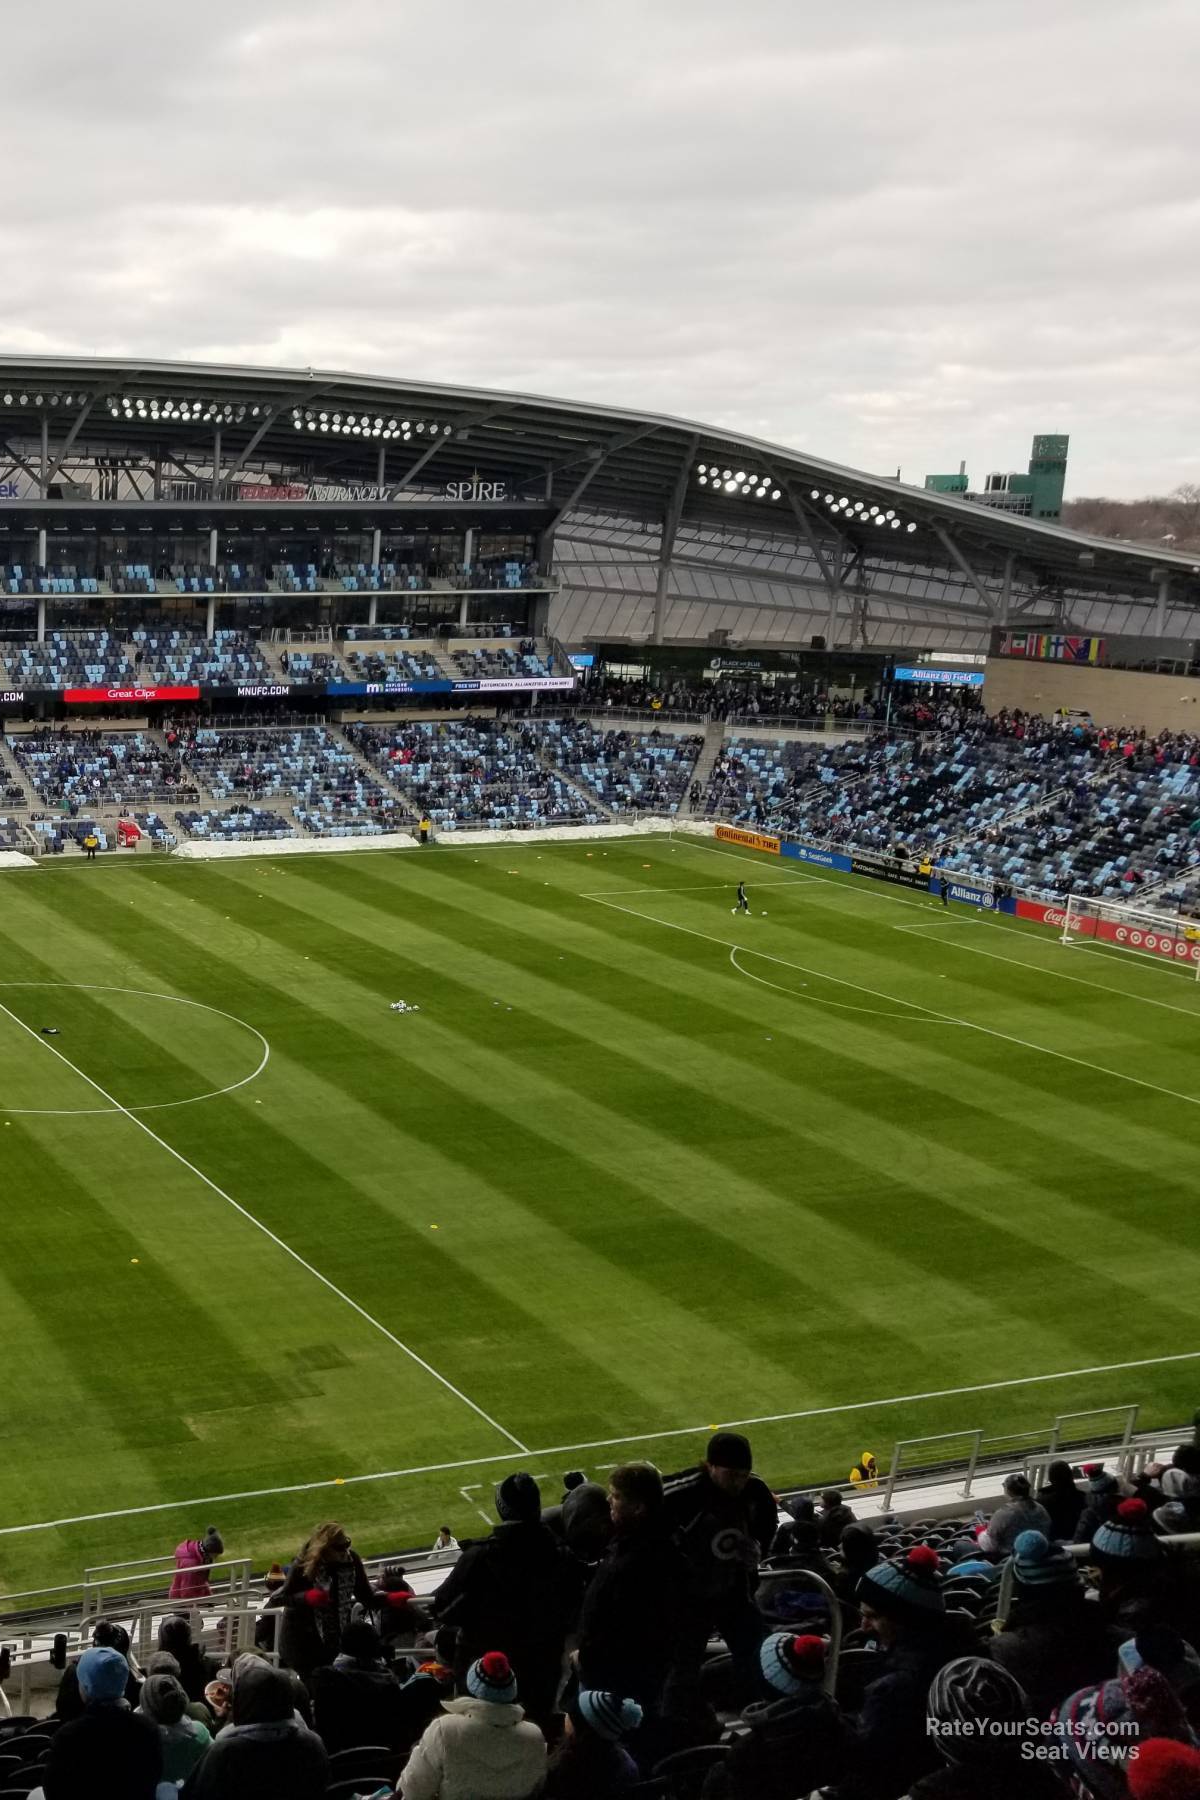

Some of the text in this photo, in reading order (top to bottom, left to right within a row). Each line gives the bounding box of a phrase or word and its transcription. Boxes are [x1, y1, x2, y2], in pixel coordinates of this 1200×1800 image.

[446, 482, 506, 501] SPIRE
[912, 670, 972, 681] Allianz Field
[107, 689, 156, 699] Great Clips
[237, 686, 289, 696] MNUFC.COM
[716, 826, 778, 850] Continental TIRE
[807, 851, 833, 864] SeatGeek
[950, 885, 981, 902] Allianz
